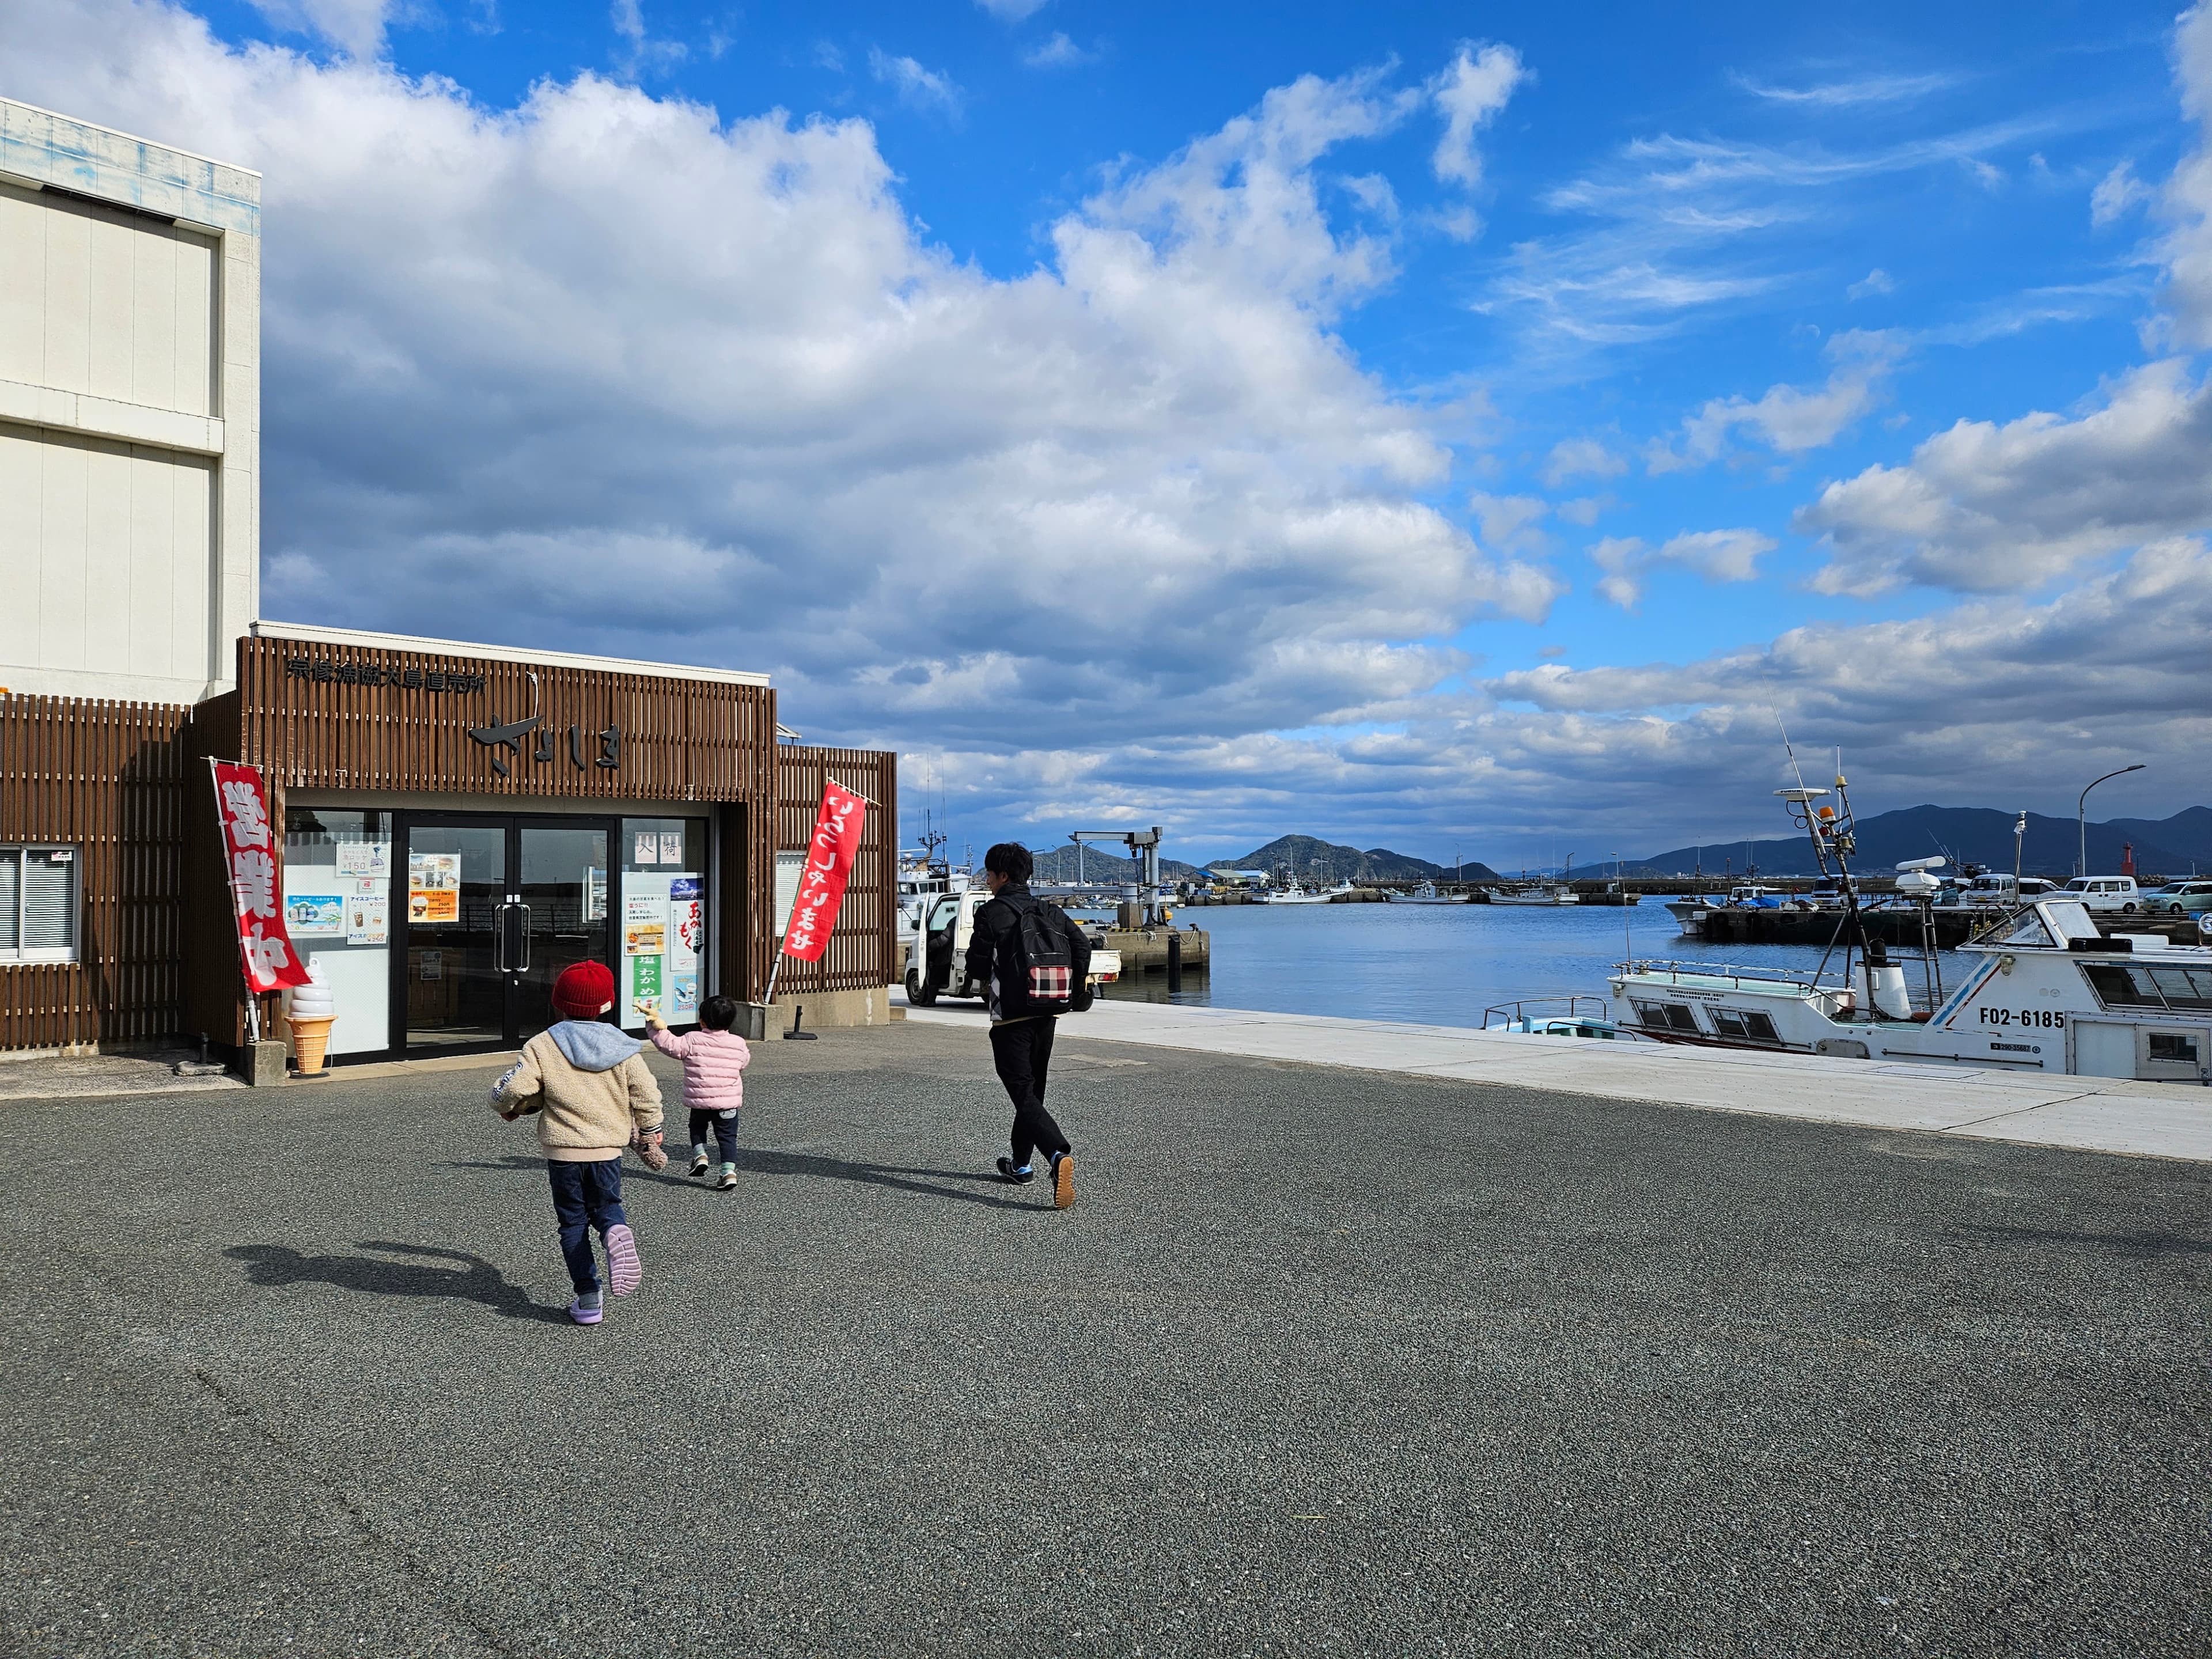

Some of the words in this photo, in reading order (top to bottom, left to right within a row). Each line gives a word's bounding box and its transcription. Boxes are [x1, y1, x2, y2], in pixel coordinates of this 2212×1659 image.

[288, 658, 486, 695] 宗像漁協大島直売所
[221, 781, 289, 987] 営業中
